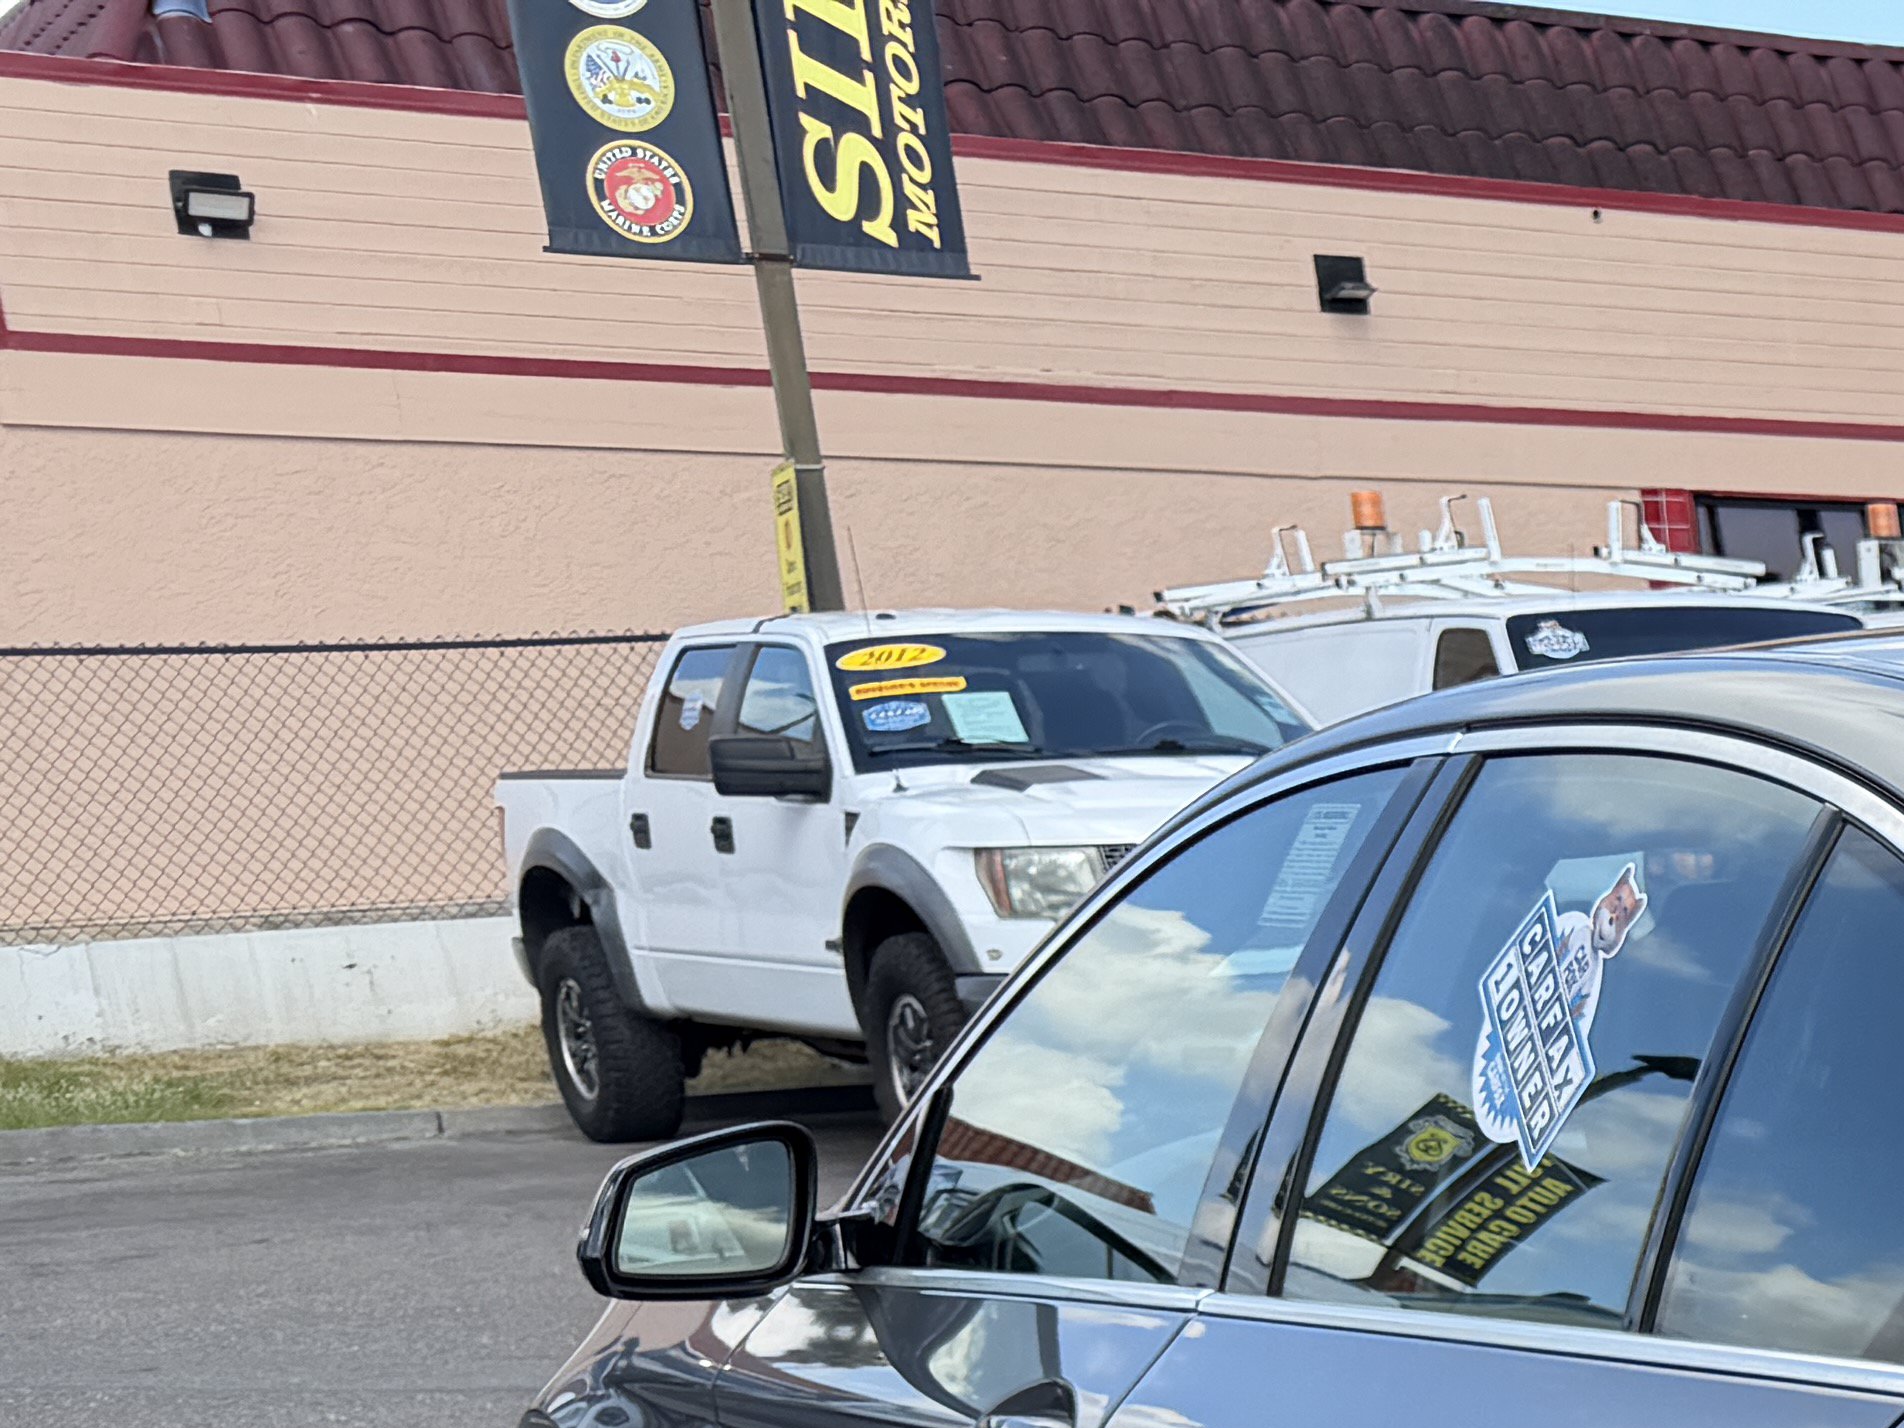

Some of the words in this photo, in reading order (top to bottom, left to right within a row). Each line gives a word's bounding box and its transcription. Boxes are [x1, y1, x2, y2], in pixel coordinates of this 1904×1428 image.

[879, 0, 941, 249] MOTOR
[858, 648, 926, 666] 2012
[1500, 990, 1551, 1140] OWNER
[1522, 921, 1575, 1101] CARFAX
